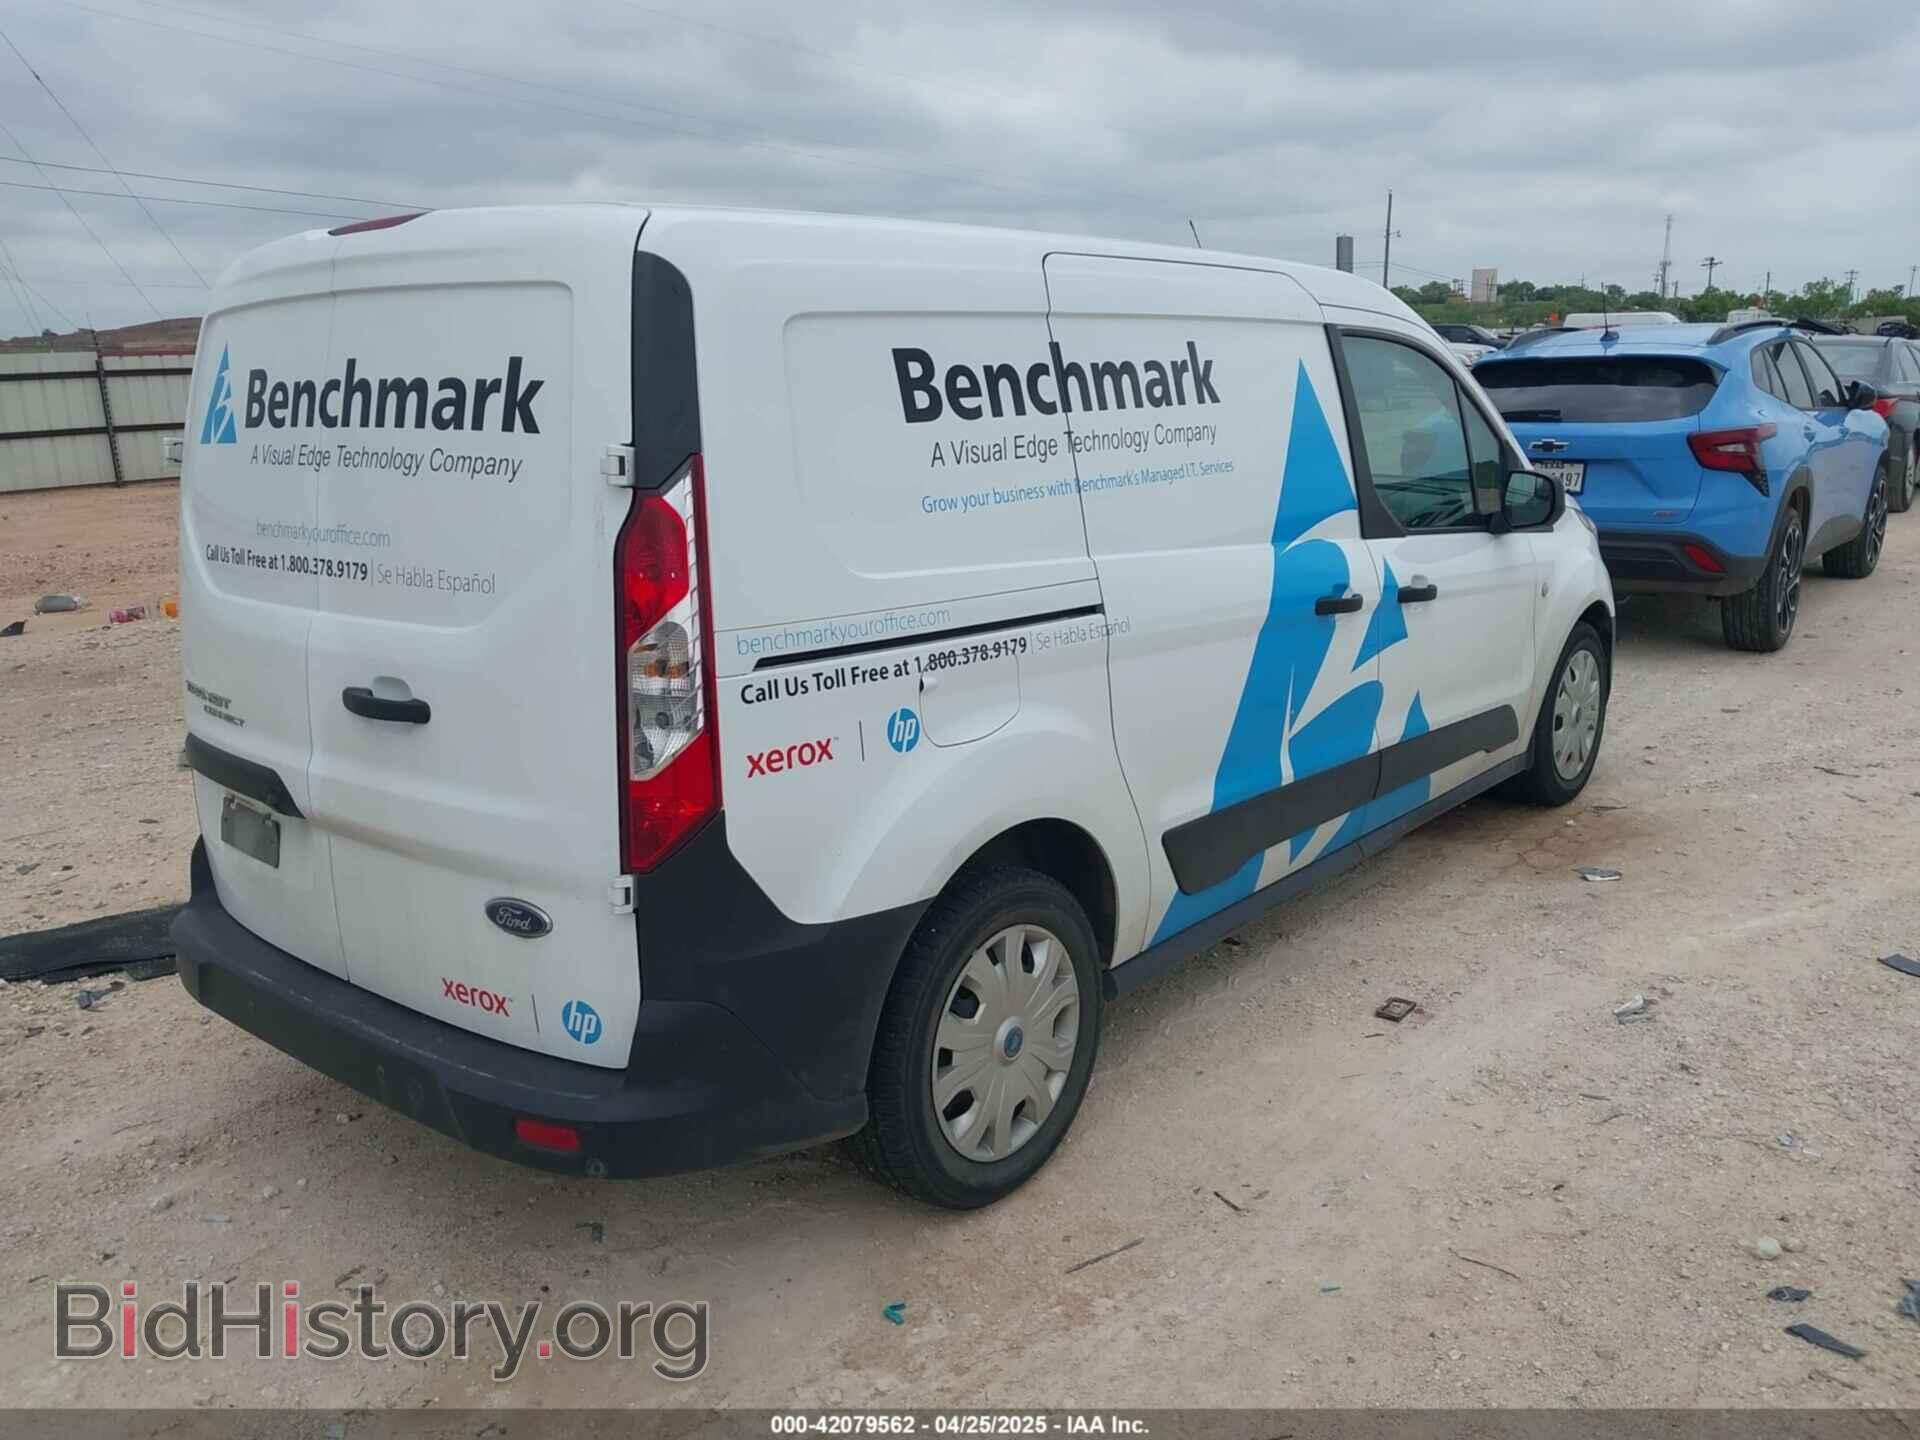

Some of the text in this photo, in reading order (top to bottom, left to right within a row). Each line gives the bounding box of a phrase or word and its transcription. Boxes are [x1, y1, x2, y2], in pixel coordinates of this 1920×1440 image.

[244, 356, 545, 434] Benchmark
[892, 341, 1220, 423] Benchmark
[249, 444, 523, 483] A Visual Edge Technology Company
[930, 424, 1217, 468] A Visual Edge Technology Company
[922, 495, 958, 513] Grow
[960, 489, 990, 514] your
[994, 485, 1045, 504] business
[1047, 479, 1073, 497] with
[1075, 471, 1139, 494] Benchmark's
[1140, 464, 1185, 486] Managed
[1199, 459, 1234, 475] Services
[256, 518, 391, 548] benchmarkyouroffice.com
[206, 544, 496, 595] Call Us Toll Free at 1.800.378.9179 Se Habla Español
[736, 607, 951, 656] benchmarkyouroffice.com
[741, 616, 1131, 704] Call Us Toll Free at 1.800.378.9179 Se Habla Español
[890, 708, 916, 752] hp
[746, 738, 834, 778] xerox
[495, 906, 531, 930] Ford
[442, 977, 511, 1017] xerox
[568, 1000, 598, 1042] hp
